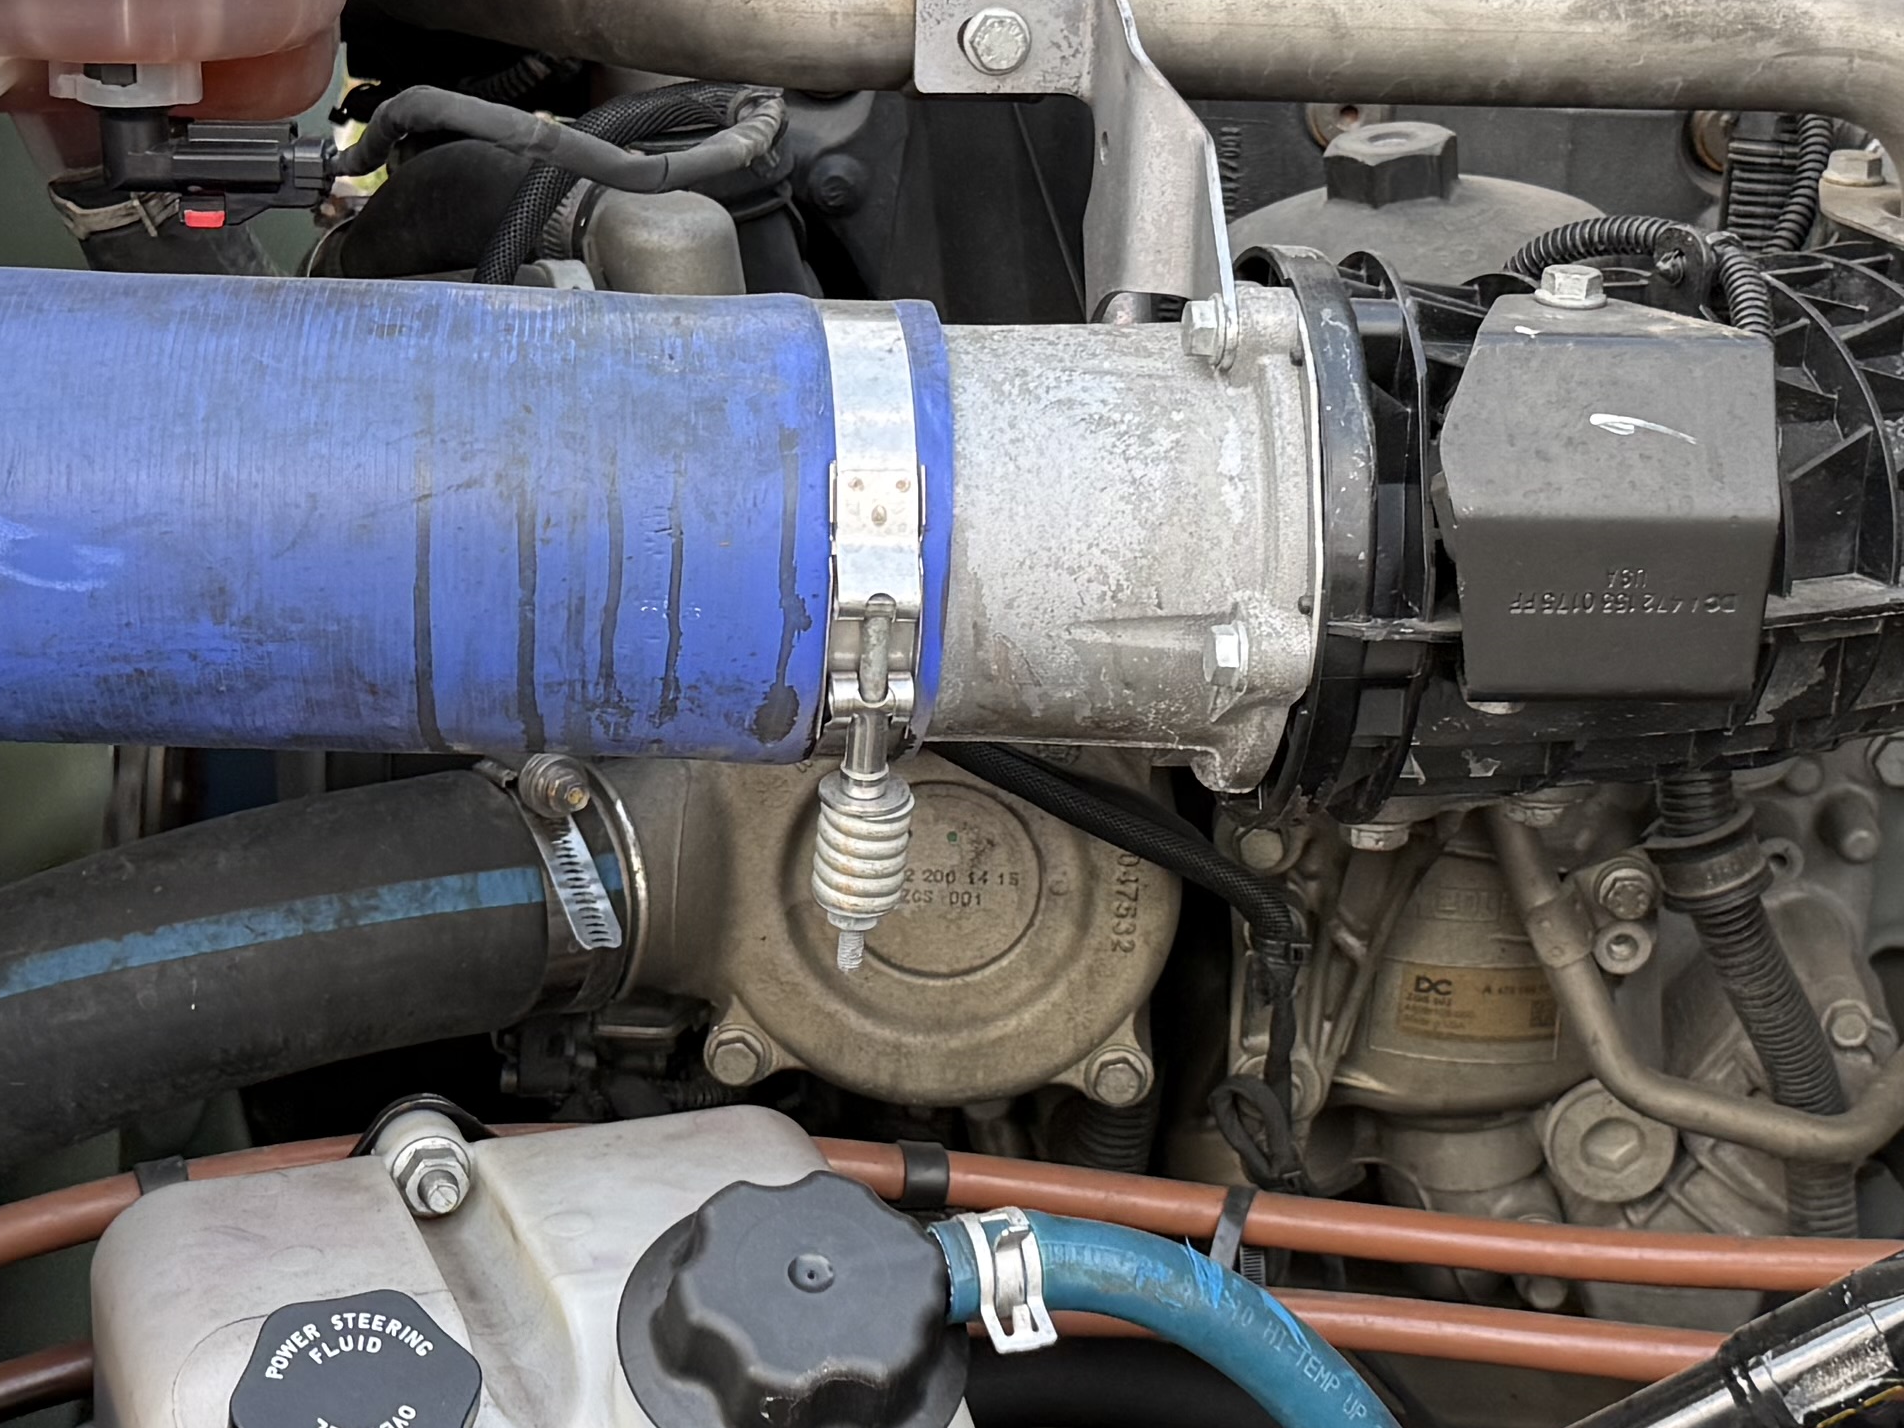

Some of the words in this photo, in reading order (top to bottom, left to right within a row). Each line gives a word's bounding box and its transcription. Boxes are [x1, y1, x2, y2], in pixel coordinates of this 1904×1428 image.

[1605, 568, 1648, 589] USA
[922, 870, 956, 885] 200
[1414, 975, 1452, 996] DC
[265, 1323, 321, 1380] POWER
[330, 1312, 434, 1357] STEERING
[308, 1334, 382, 1364] FLUID
[1262, 1314, 1342, 1394] HI-TEMP
[1342, 1392, 1370, 1424] UP
